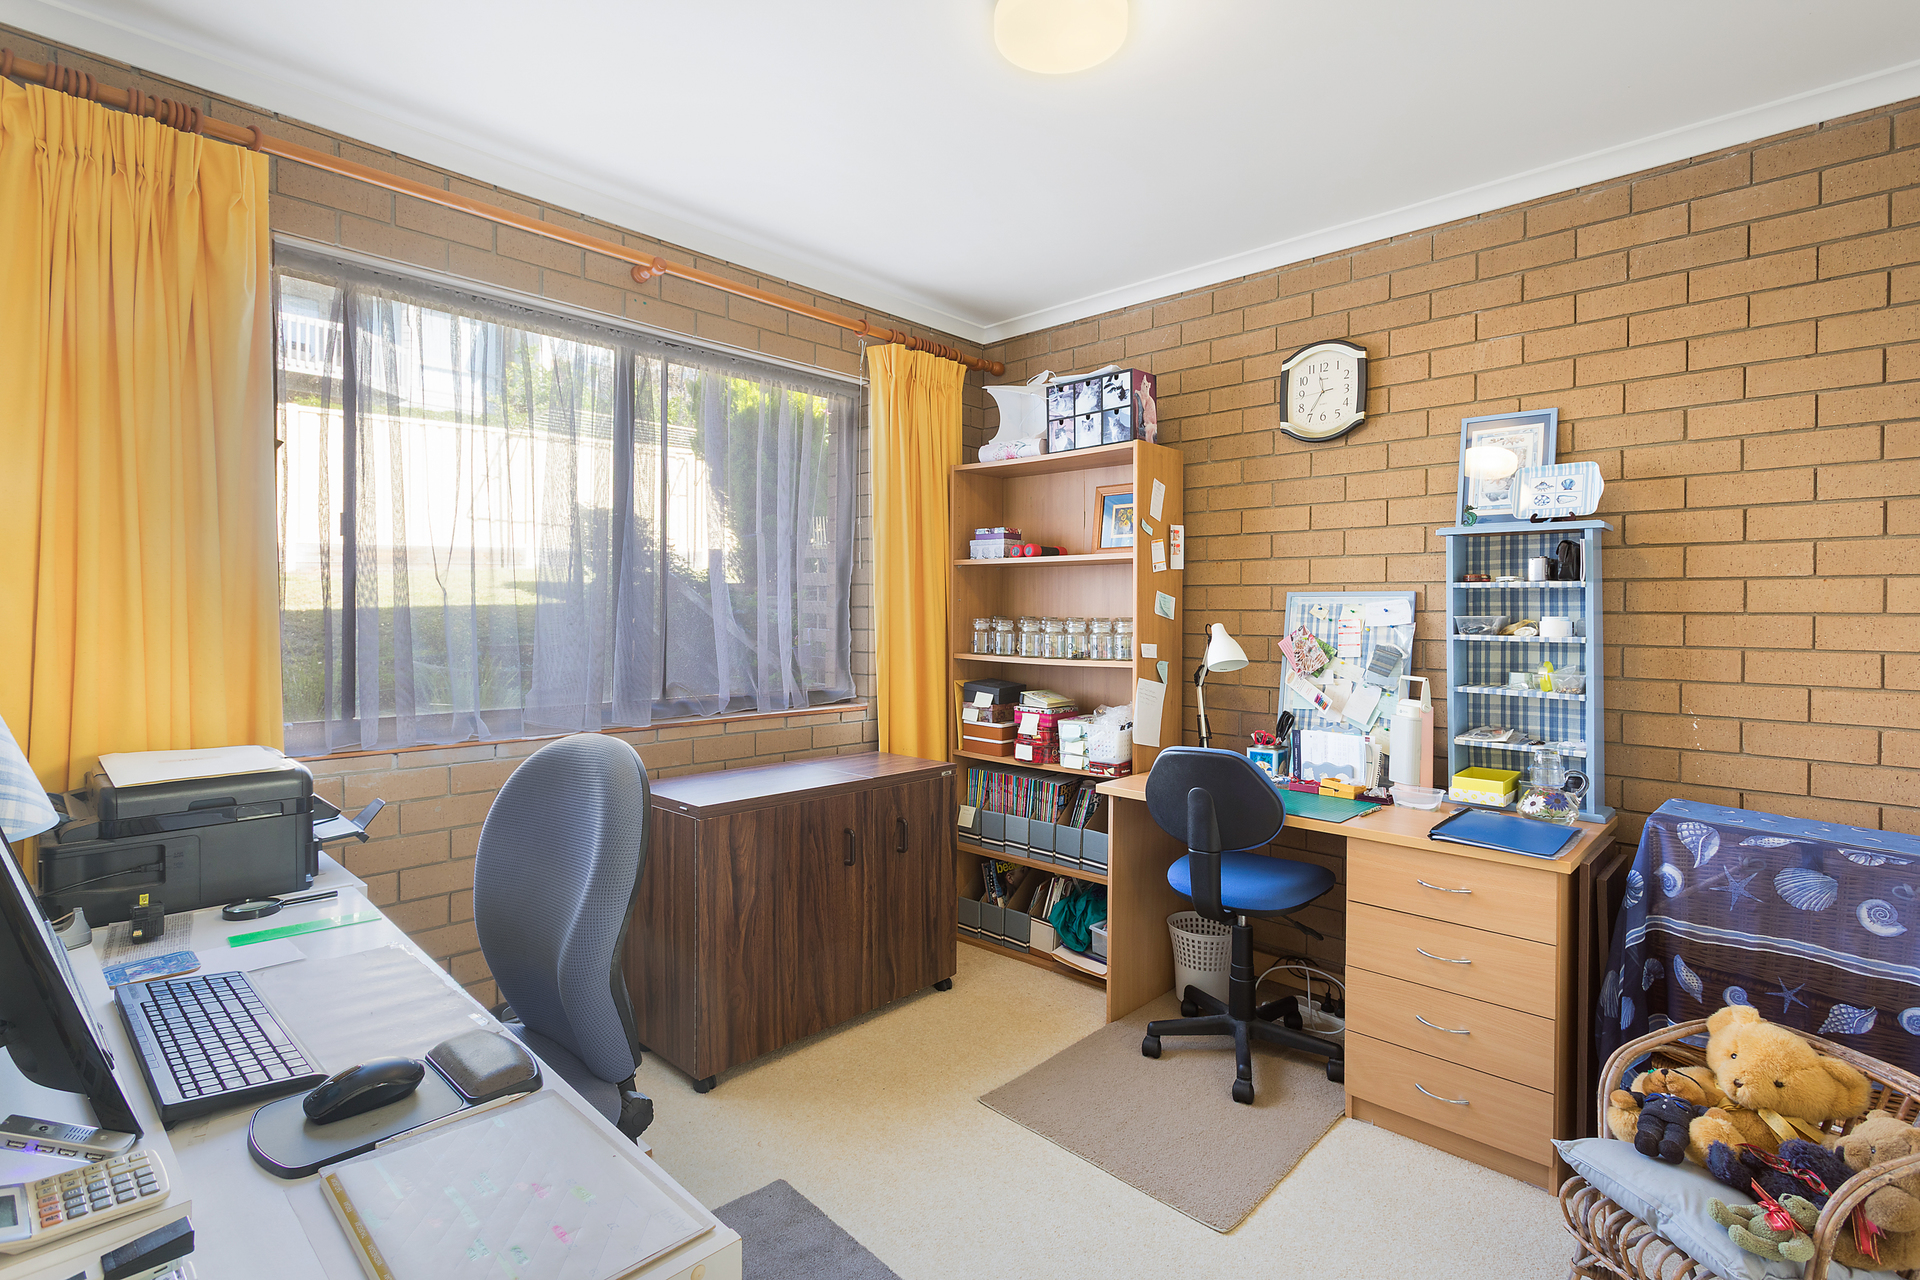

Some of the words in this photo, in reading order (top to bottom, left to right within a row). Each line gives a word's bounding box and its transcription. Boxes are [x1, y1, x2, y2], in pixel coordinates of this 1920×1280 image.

[1308, 364, 1315, 374] 11
[1319, 362, 1329, 373] 12
[1343, 369, 1350, 380] 2
[1299, 376, 1309, 387] 10
[1343, 383, 1350, 394] 3
[1298, 390, 1306, 400] 9
[1342, 397, 1349, 407] 4
[1298, 403, 1305, 414] 8
[1334, 408, 1341, 419] 5
[1306, 413, 1313, 423] 7
[1319, 411, 1327, 422] 6
